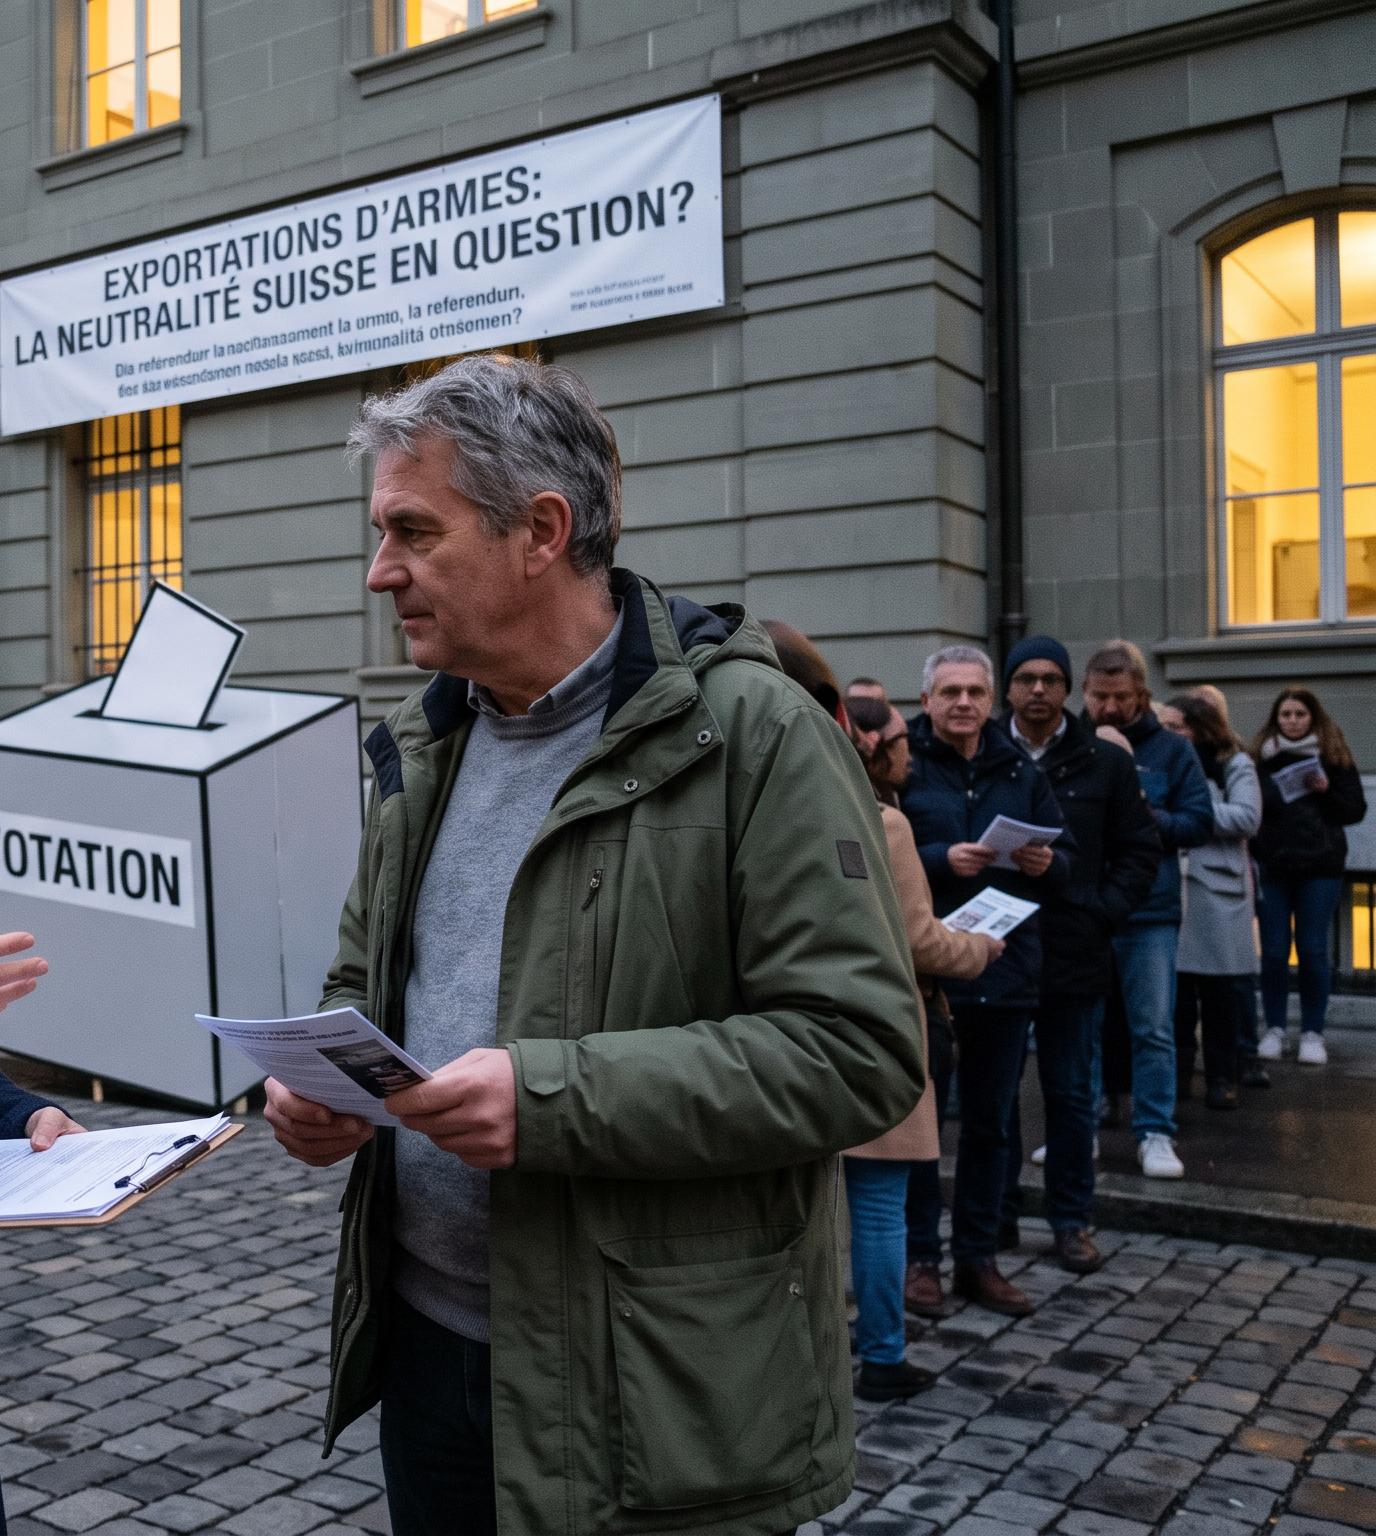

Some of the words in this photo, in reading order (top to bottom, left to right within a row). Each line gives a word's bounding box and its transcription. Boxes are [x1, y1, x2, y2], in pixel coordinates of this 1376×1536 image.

[15, 330, 49, 367] LA
[56, 275, 242, 358] NEUTRALITÉ
[252, 253, 378, 315] SUISSE
[390, 238, 438, 285] EN
[453, 180, 696, 272] QUESTION?
[103, 212, 344, 303] EXPORTATIONS
[338, 317, 352, 335] la
[408, 303, 422, 320] la
